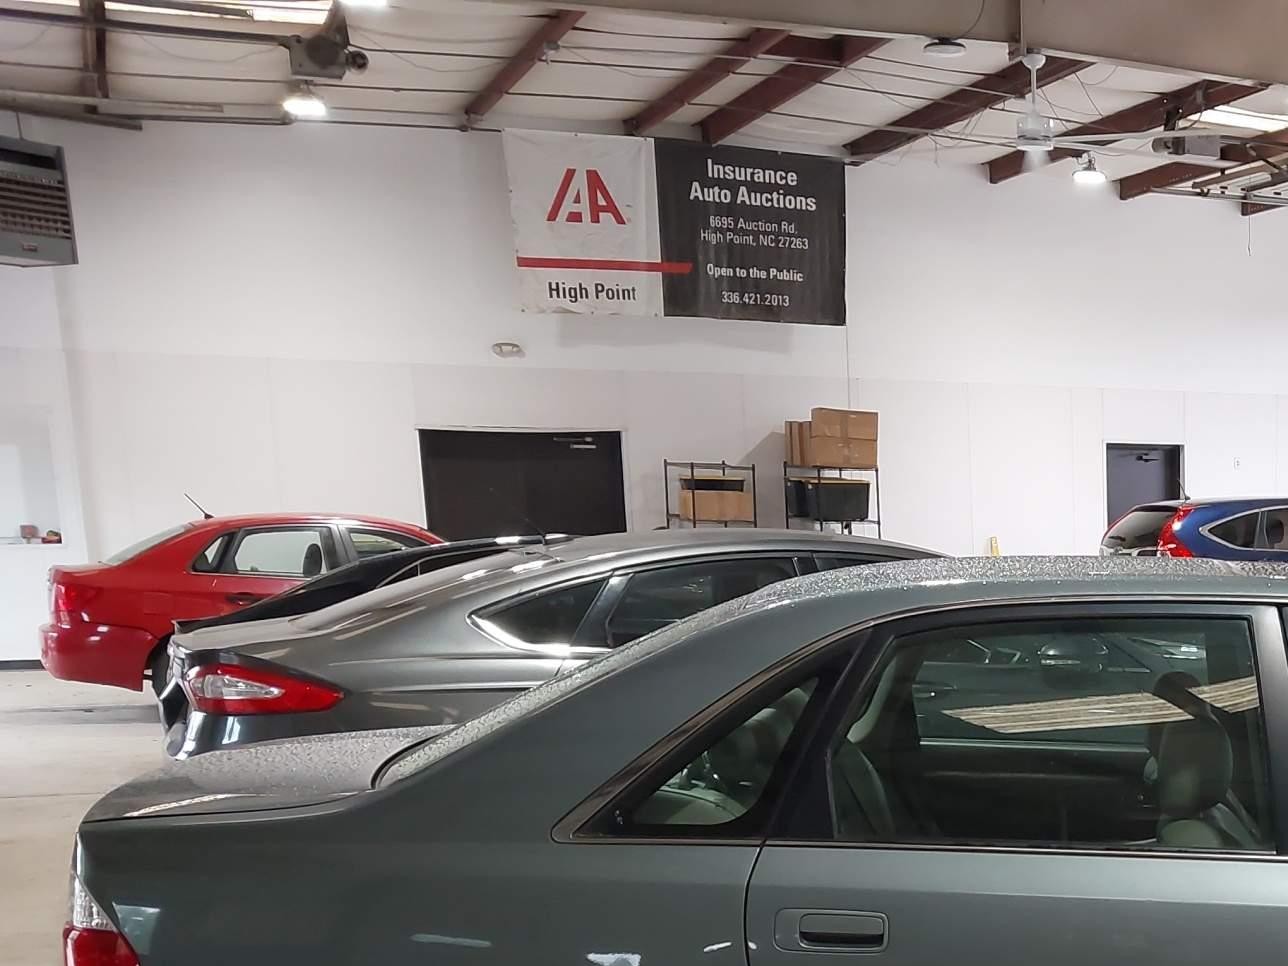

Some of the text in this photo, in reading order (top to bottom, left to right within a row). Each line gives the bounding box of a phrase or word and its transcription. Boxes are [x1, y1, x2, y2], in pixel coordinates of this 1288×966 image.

[707, 158, 798, 186] Insurance
[689, 181, 817, 211] Auto Auctions
[709, 216, 734, 229] 6695
[737, 218, 778, 233] Auction
[700, 229, 809, 250] High Point, NC 27263
[706, 263, 804, 282] Open to the Public
[547, 281, 636, 304] High Point
[721, 291, 790, 307] 336.421.2013
